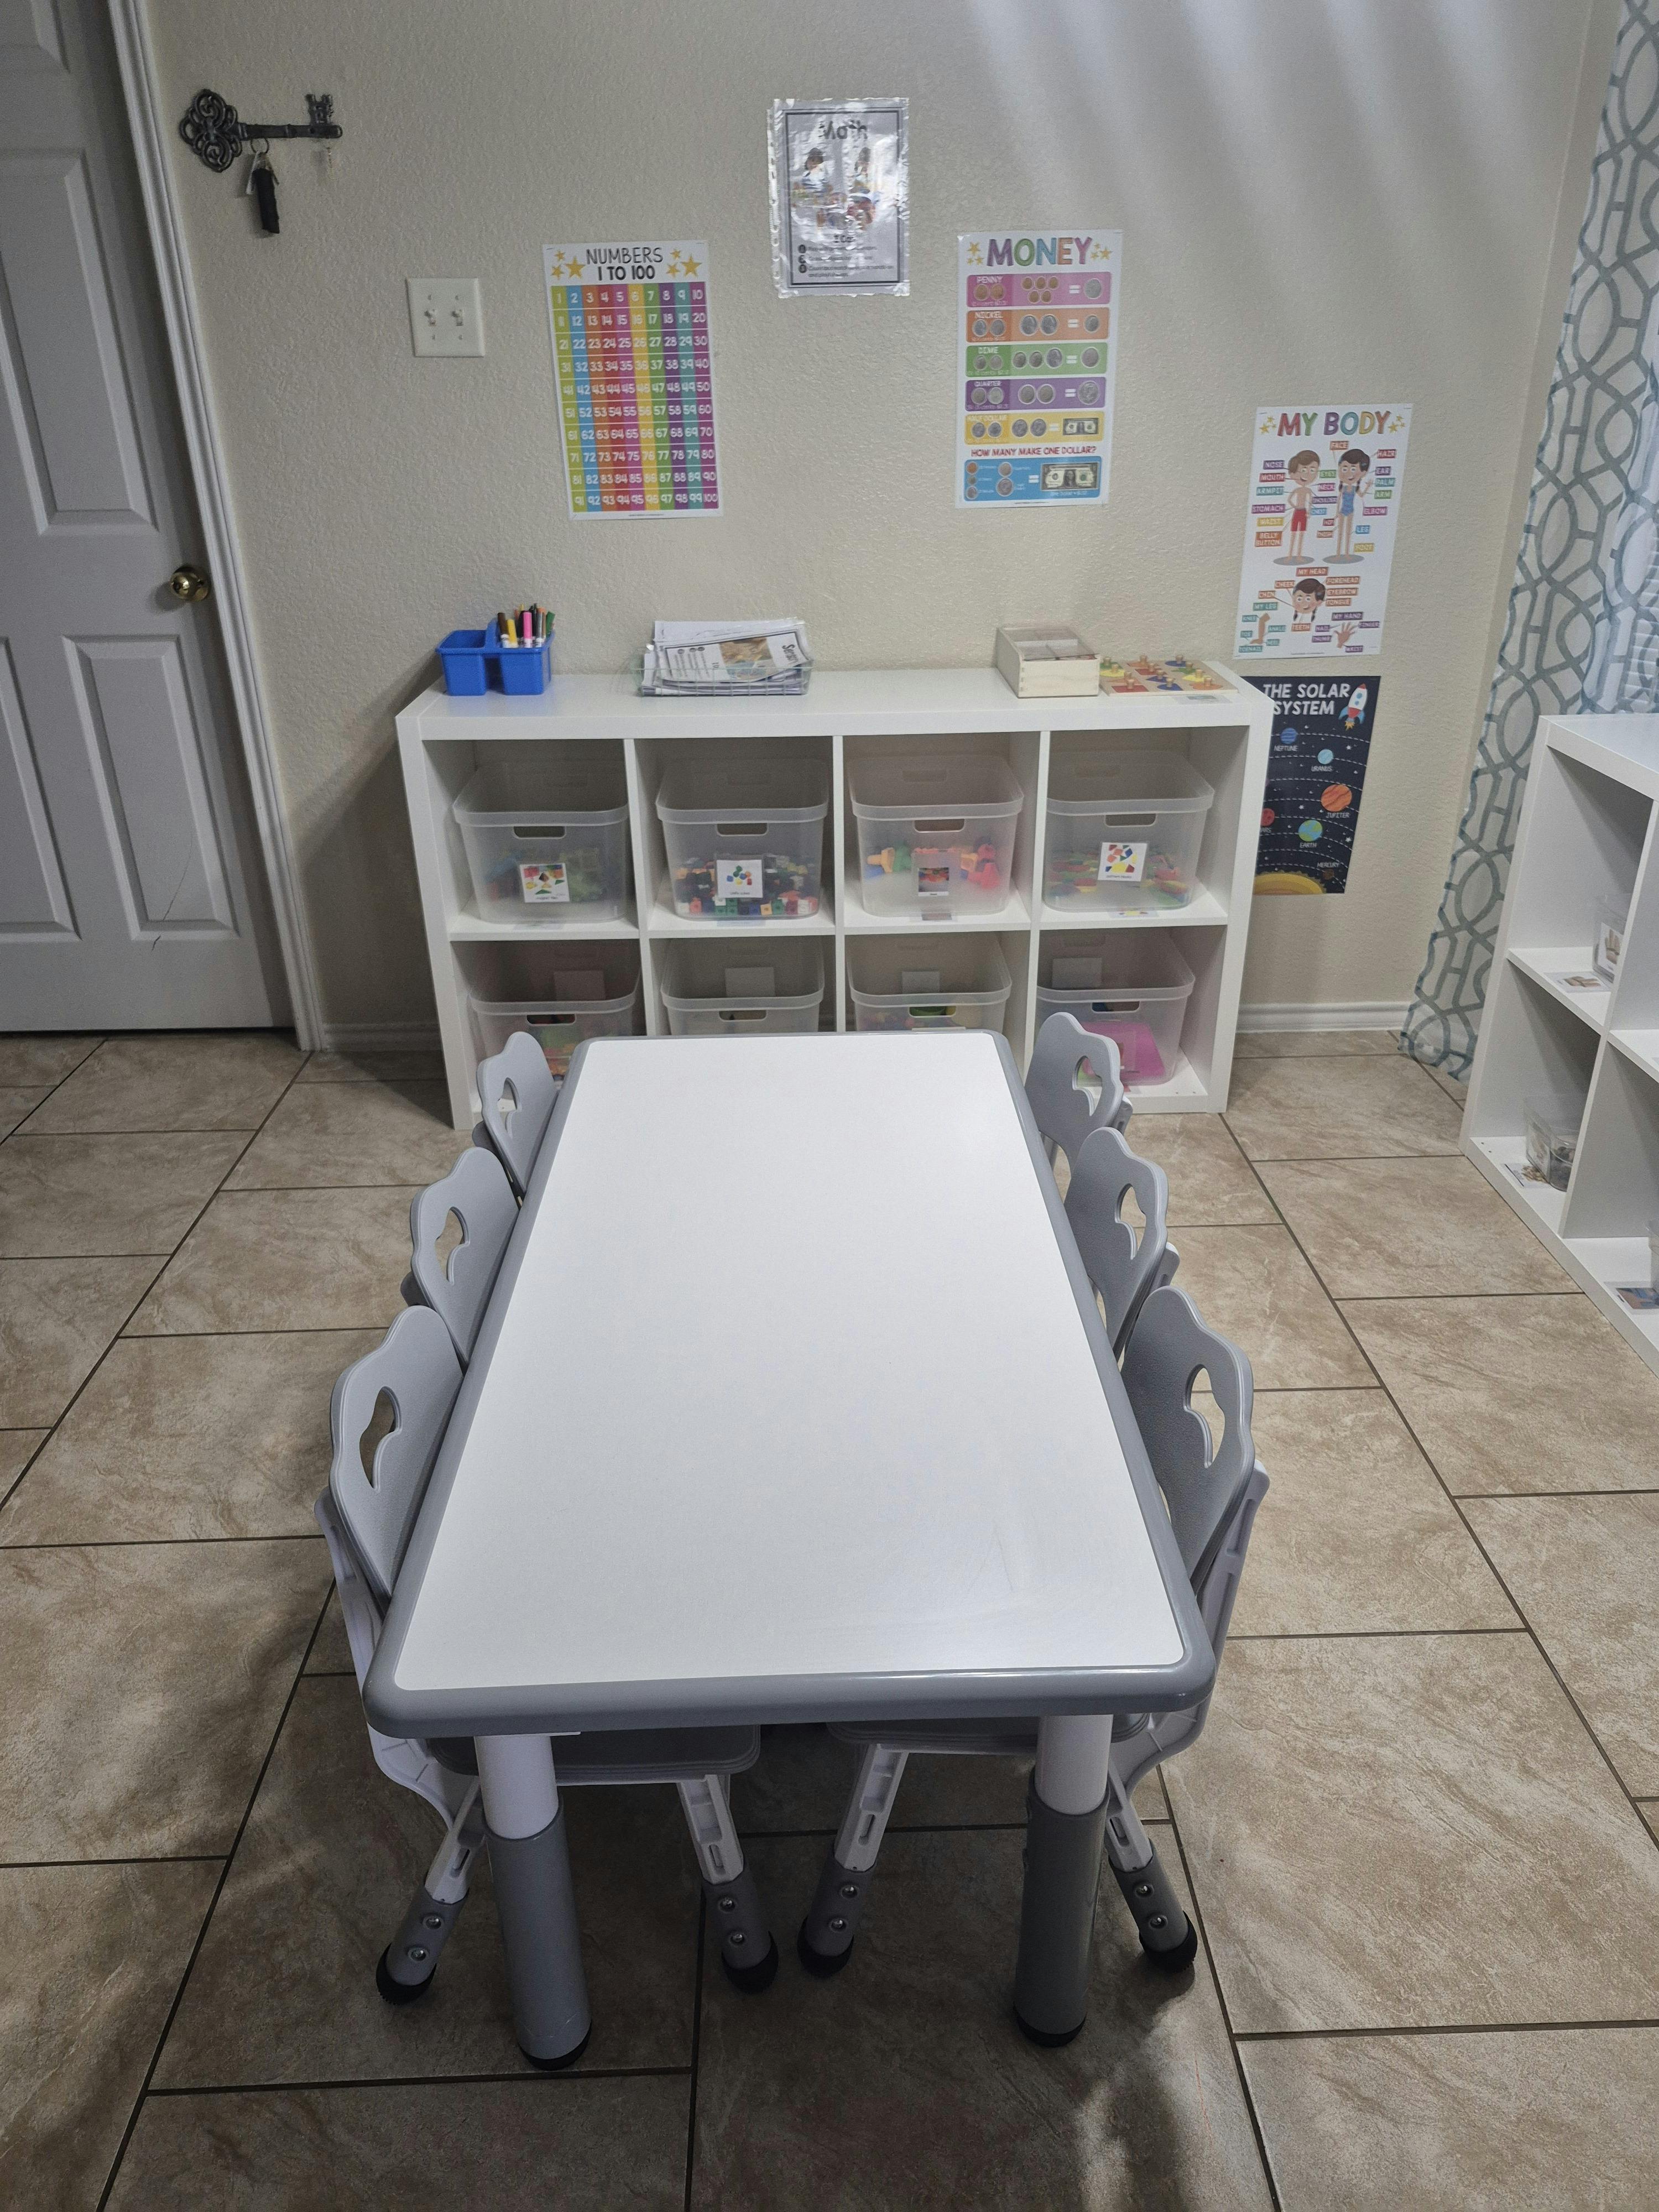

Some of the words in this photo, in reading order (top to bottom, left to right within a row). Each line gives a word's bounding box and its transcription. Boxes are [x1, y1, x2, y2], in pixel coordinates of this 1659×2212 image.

[586, 247, 664, 265] NUMBERS
[987, 236, 1093, 267] MONEY
[598, 266, 603, 281] 1
[608, 265, 627, 281] TO
[632, 265, 656, 280] 100
[571, 293, 578, 303] 2
[586, 292, 593, 302] 3
[601, 291, 609, 302] 4
[616, 291, 624, 302] 5
[647, 290, 654, 300] 7
[662, 290, 670, 300] 8
[677, 289, 685, 300] 9
[692, 289, 703, 300] 10
[648, 314, 657, 324] 17
[692, 312, 706, 322] 20
[572, 338, 586, 349] 22
[587, 338, 601, 348] 23
[602, 338, 616, 348] 24
[618, 337, 632, 348] 25
[649, 336, 661, 347] 27
[664, 336, 677, 346] 28
[679, 336, 692, 346] 29
[693, 335, 708, 346] 30
[575, 362, 588, 372] 32
[650, 359, 663, 369] 37
[665, 359, 679, 369] 38
[680, 358, 693, 369] 39
[695, 357, 709, 368] 40
[576, 384, 591, 394] 42
[621, 383, 635, 393] 45
[651, 382, 665, 392] 47
[681, 382, 696, 392] 49
[696, 381, 711, 392] 50
[578, 407, 592, 417] 52
[593, 406, 607, 417] 53
[608, 406, 622, 416] 54
[623, 406, 637, 416] 55
[654, 405, 666, 415] 57
[667, 405, 681, 415] 58
[682, 404, 697, 414] 59
[697, 404, 712, 414] 60
[1277, 412, 1318, 436] MY
[1323, 411, 1391, 436] BODY
[581, 429, 594, 440] 62
[596, 429, 609, 439] 63
[625, 429, 639, 438] 65
[655, 427, 667, 437] 67
[669, 427, 683, 437] 68
[685, 426, 698, 437] 69
[699, 425, 713, 437] 70
[583, 452, 596, 462] 72
[597, 451, 611, 461] 73
[612, 451, 625, 461] 74
[627, 451, 640, 461] 75
[658, 450, 669, 460] 77
[671, 450, 684, 460] 78
[686, 449, 700, 459] 79
[701, 449, 715, 459] 80
[971, 448, 990, 457] HOW
[992, 448, 1015, 456] MANY
[1018, 447, 1041, 455] MAKE
[1044, 446, 1060, 455] ONE
[1061, 445, 1097, 454] DOLLAR?
[586, 474, 598, 484] 82
[599, 474, 613, 483] 83
[614, 473, 628, 483] 84
[629, 473, 642, 483] 85
[659, 472, 671, 482] 87
[673, 472, 686, 482] 88
[687, 472, 701, 481] 89
[702, 471, 716, 481] 90
[587, 495, 601, 505] 92
[601, 495, 615, 504] 93
[616, 495, 630, 504] 94
[630, 494, 644, 504] 95
[660, 493, 672, 503] 97
[675, 493, 688, 503] 98
[689, 493, 702, 502] 99
[703, 492, 718, 504] 100
[1263, 684, 1292, 698] THE
[1297, 683, 1350, 698] SOLAR
[1274, 700, 1335, 716] SYSTEM
